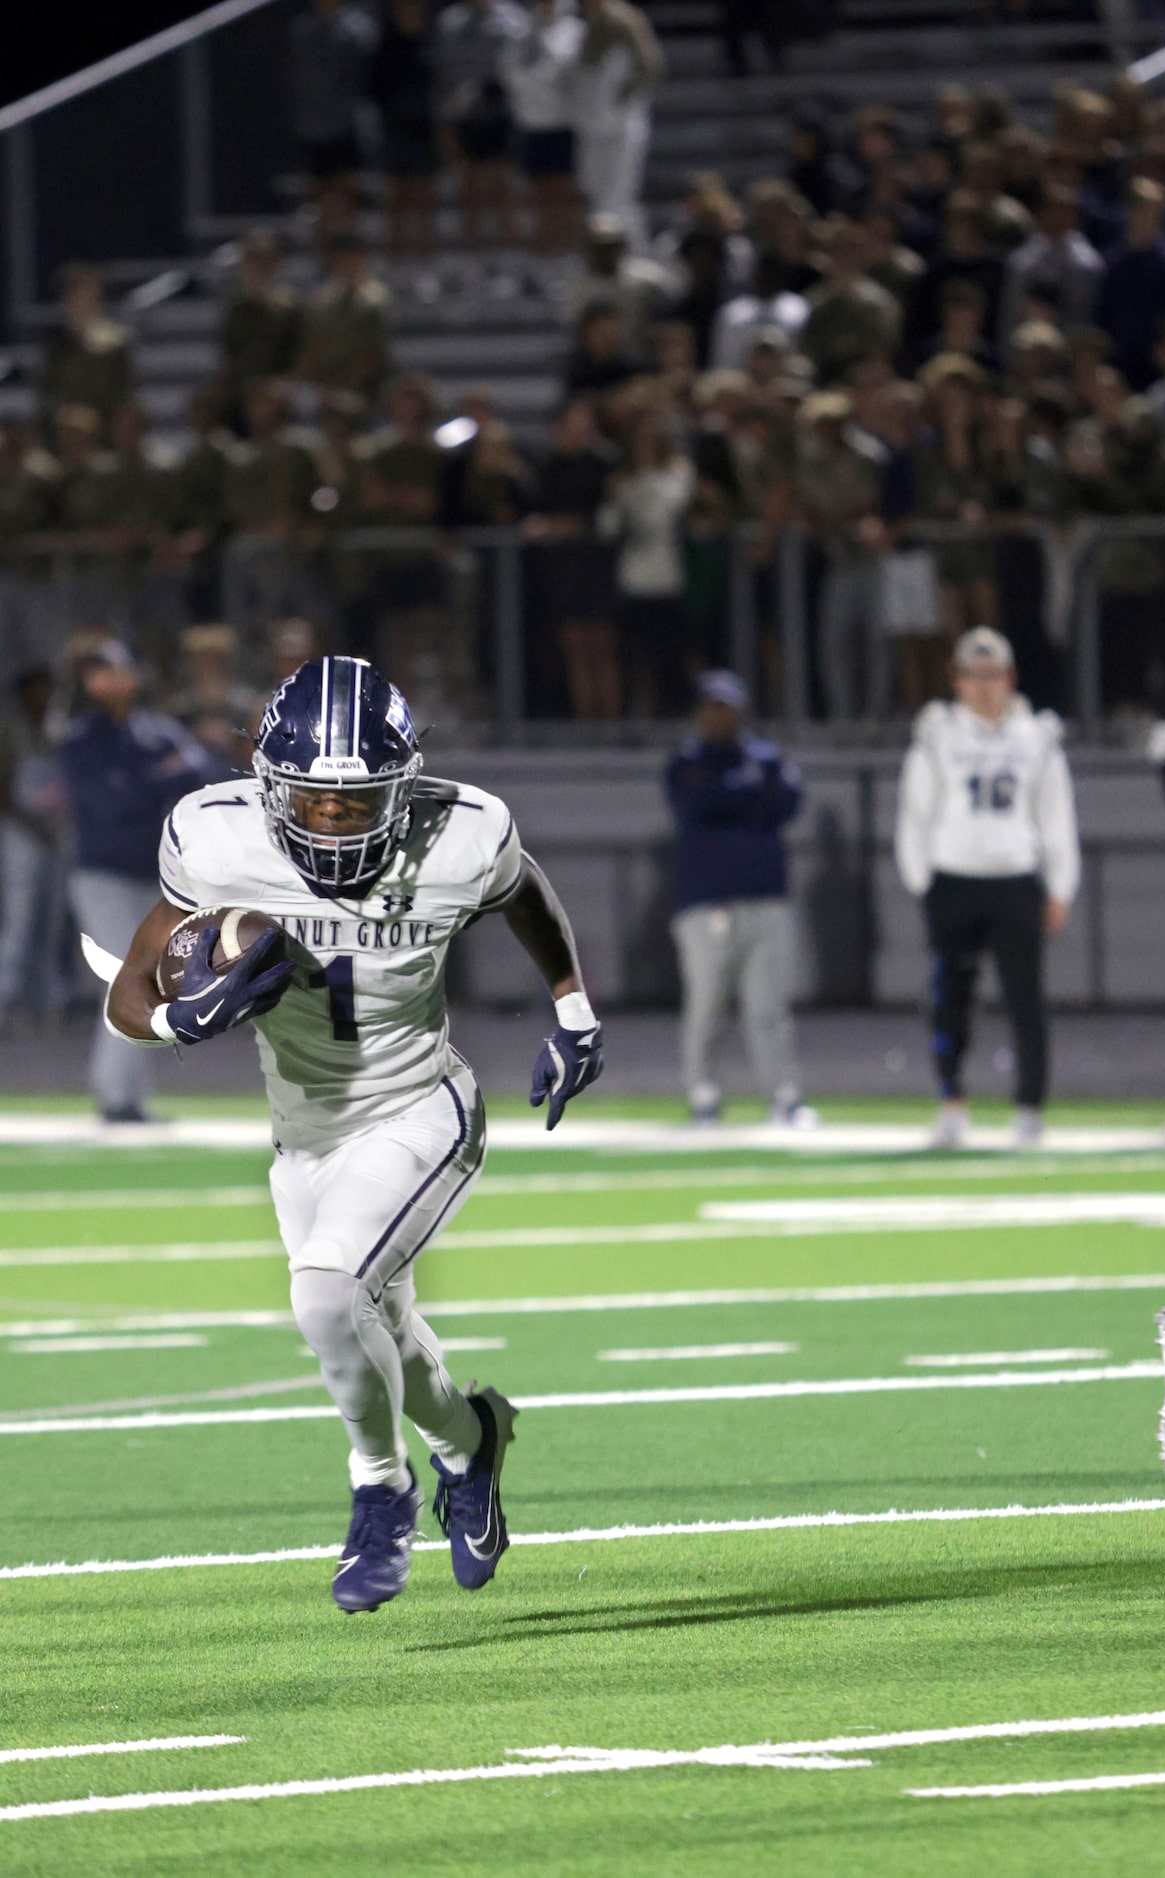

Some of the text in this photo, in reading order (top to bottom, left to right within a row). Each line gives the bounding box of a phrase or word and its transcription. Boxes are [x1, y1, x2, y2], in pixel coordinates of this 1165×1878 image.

[336, 760, 362, 770] GROVE
[357, 919, 434, 949] GROVE
[308, 955, 359, 1042] 1
